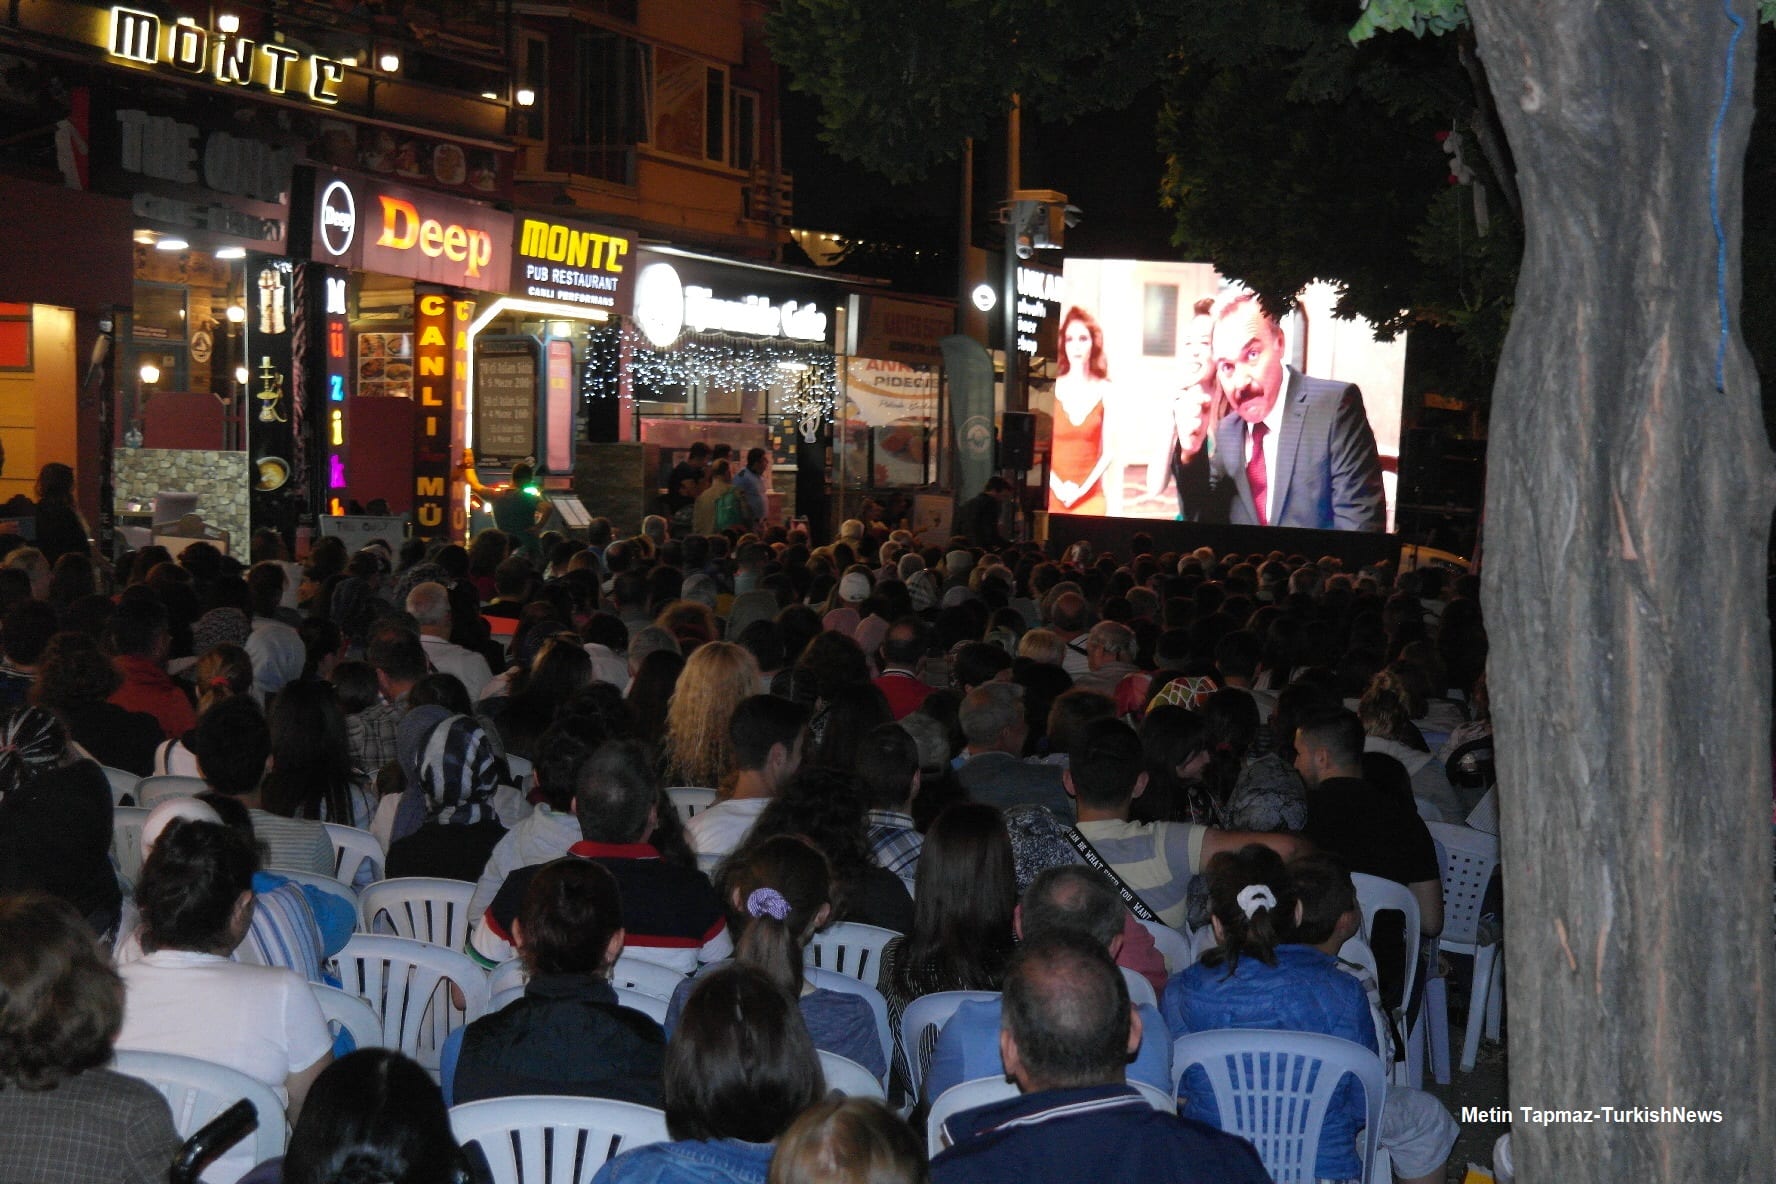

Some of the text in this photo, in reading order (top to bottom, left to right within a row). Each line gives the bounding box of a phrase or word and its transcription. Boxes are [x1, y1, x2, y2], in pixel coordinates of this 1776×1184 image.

[109, 6, 346, 104] MONTE
[376, 195, 492, 278] Deep
[520, 219, 628, 272] MONTE
[526, 264, 619, 291] PUB RESTAURANT
[528, 286, 615, 306] CANLI PERFORMANS
[417, 296, 446, 543] CANLI MÜ
[1068, 831, 1080, 843] CAN
[1077, 842, 1087, 852] BE
[1085, 850, 1104, 871] WHAT
[1120, 887, 1133, 901] YOU
[1133, 902, 1152, 920] WANT
